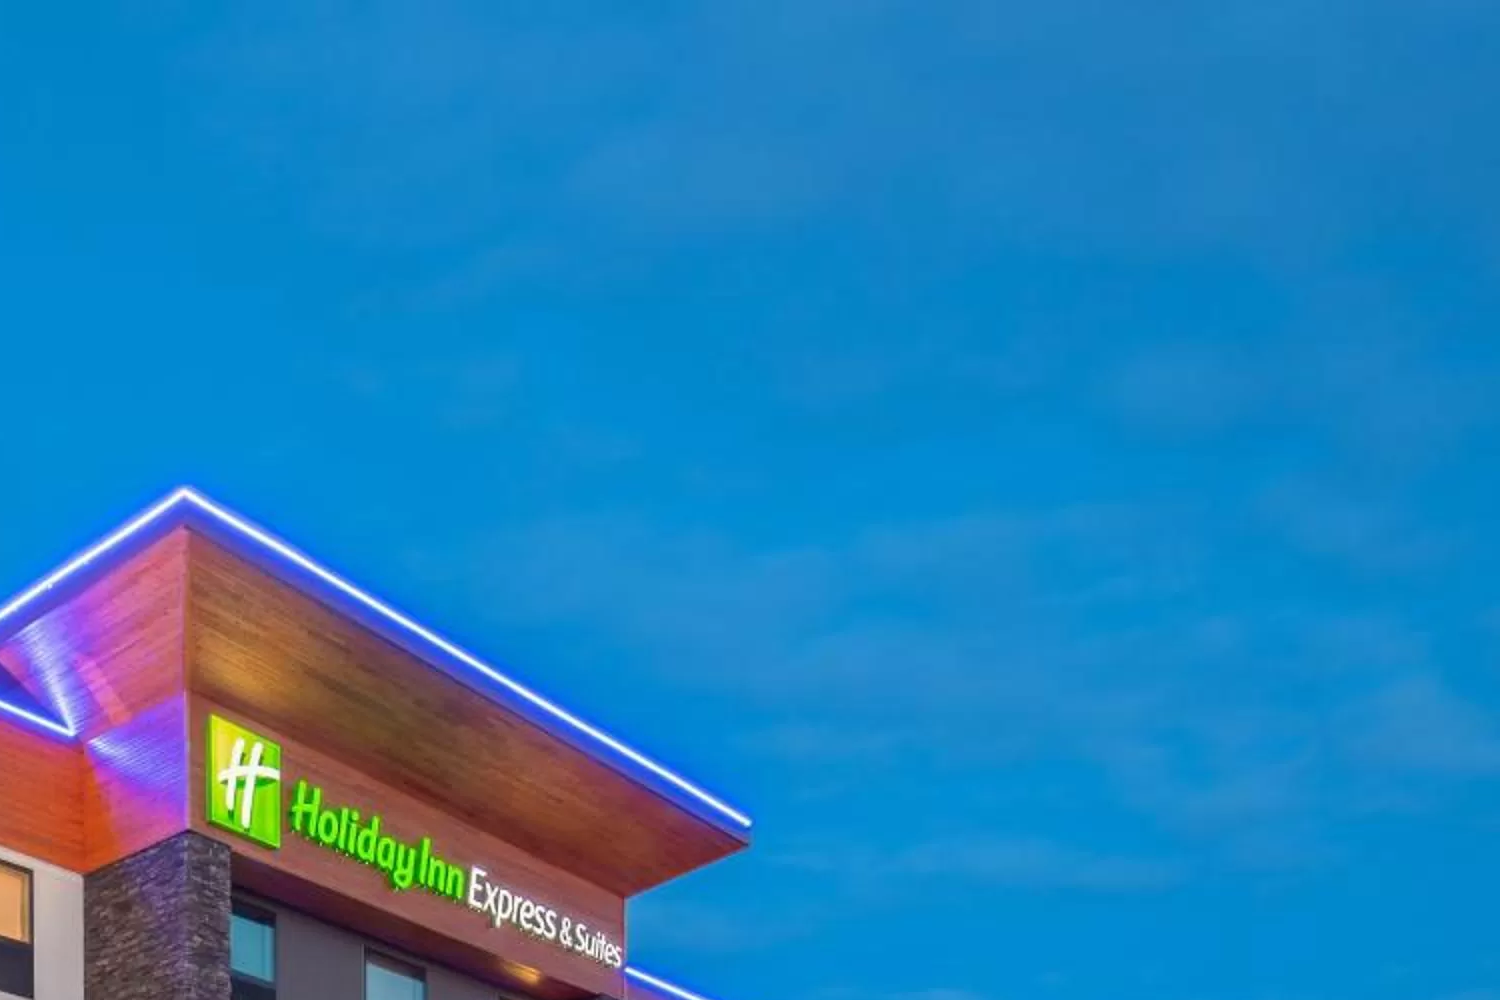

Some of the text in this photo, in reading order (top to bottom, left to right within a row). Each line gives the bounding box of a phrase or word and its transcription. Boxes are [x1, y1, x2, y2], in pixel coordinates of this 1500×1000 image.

[291, 779, 623, 968] Holiday Inn Express & Suites
